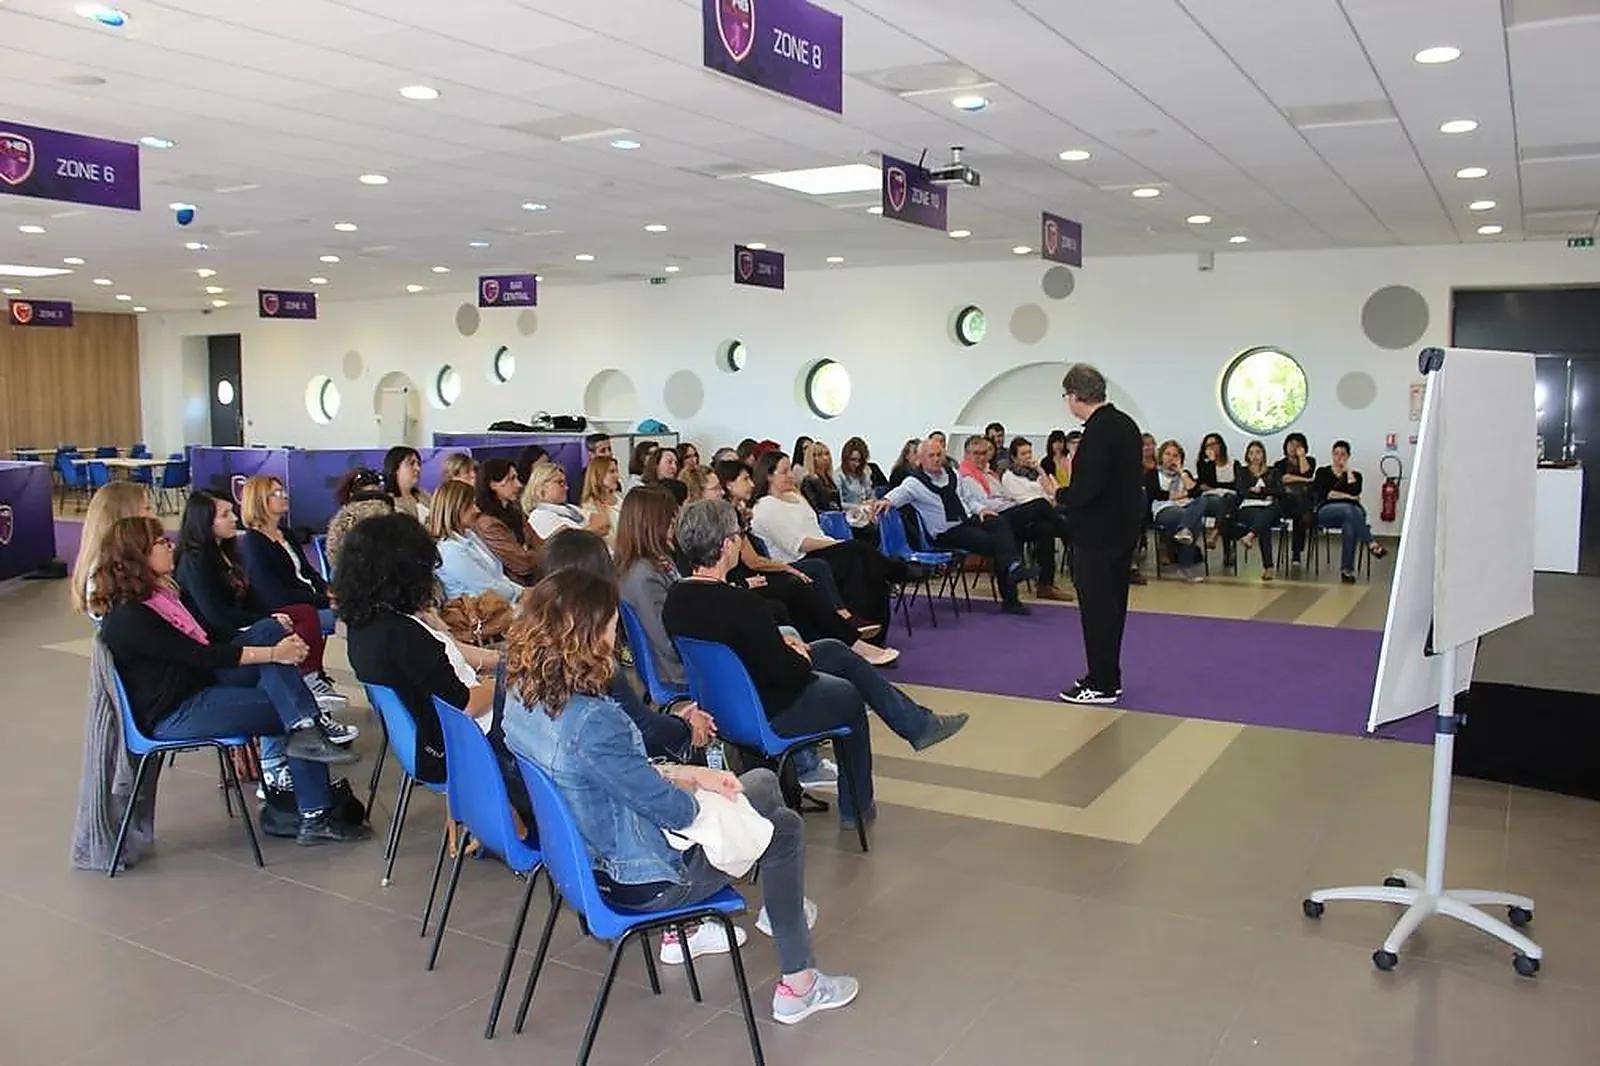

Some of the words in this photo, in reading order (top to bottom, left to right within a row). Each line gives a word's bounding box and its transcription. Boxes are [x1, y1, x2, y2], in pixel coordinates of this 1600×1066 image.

[773, 27, 809, 65] ZONE
[811, 44, 821, 69] 8
[56, 158, 101, 181] ZONE
[103, 166, 115, 183] 6
[911, 187, 930, 206] ZONE
